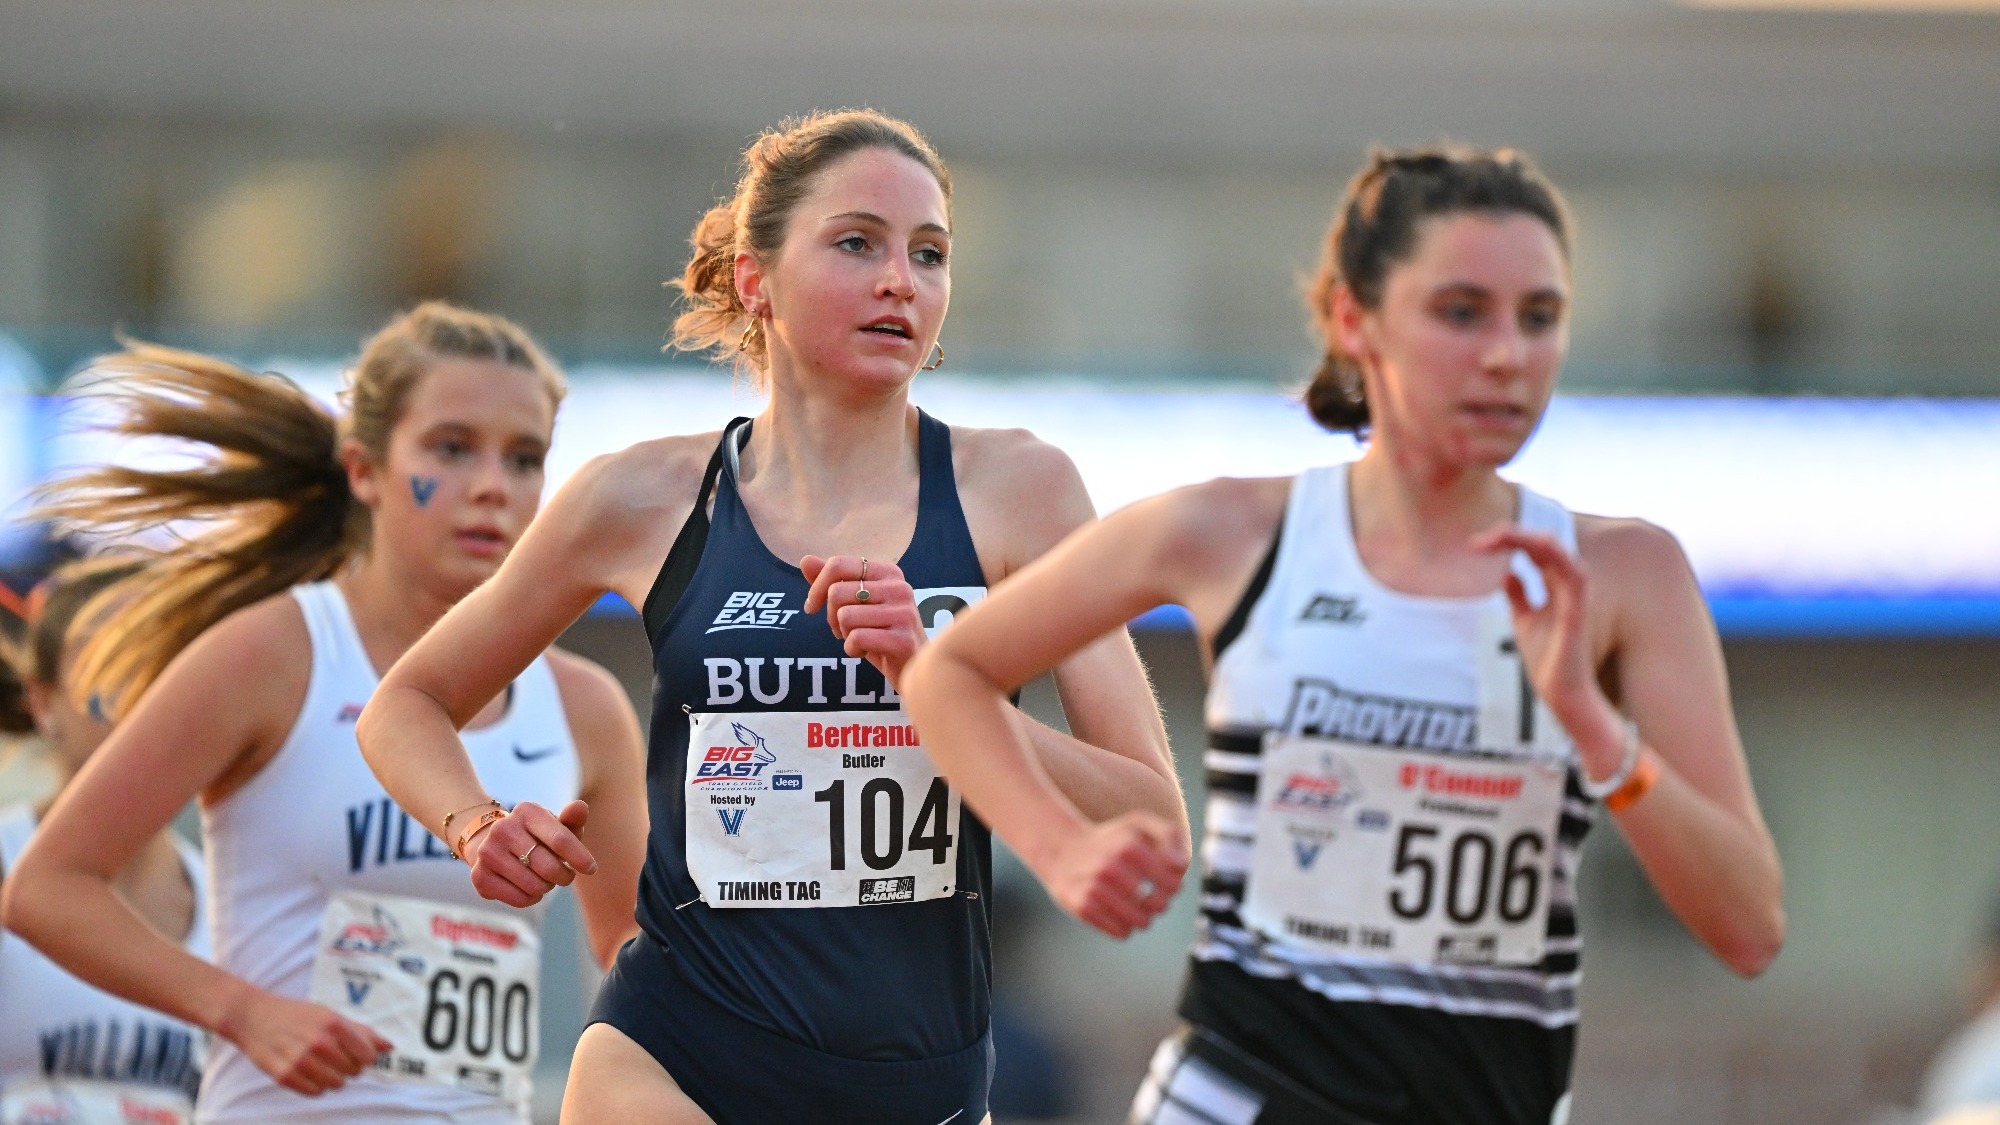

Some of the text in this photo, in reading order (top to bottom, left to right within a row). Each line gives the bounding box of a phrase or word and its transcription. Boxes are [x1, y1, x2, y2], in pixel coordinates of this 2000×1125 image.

[723, 591, 786, 609] BIG
[712, 608, 800, 625] EAST
[807, 722, 921, 749] Bertrand
[703, 746, 756, 762] BIG
[842, 753, 886, 769] Butler
[696, 762, 770, 777] EAST
[775, 778, 800, 788] Jeep
[710, 794, 756, 806] Hosted by
[716, 807, 748, 837] V
[814, 777, 953, 872] 104
[1389, 823, 1546, 925] 506
[717, 880, 821, 902] TIMING TAG
[873, 879, 899, 894] BE
[861, 890, 913, 903] CHANGE
[424, 969, 531, 1064] 600
